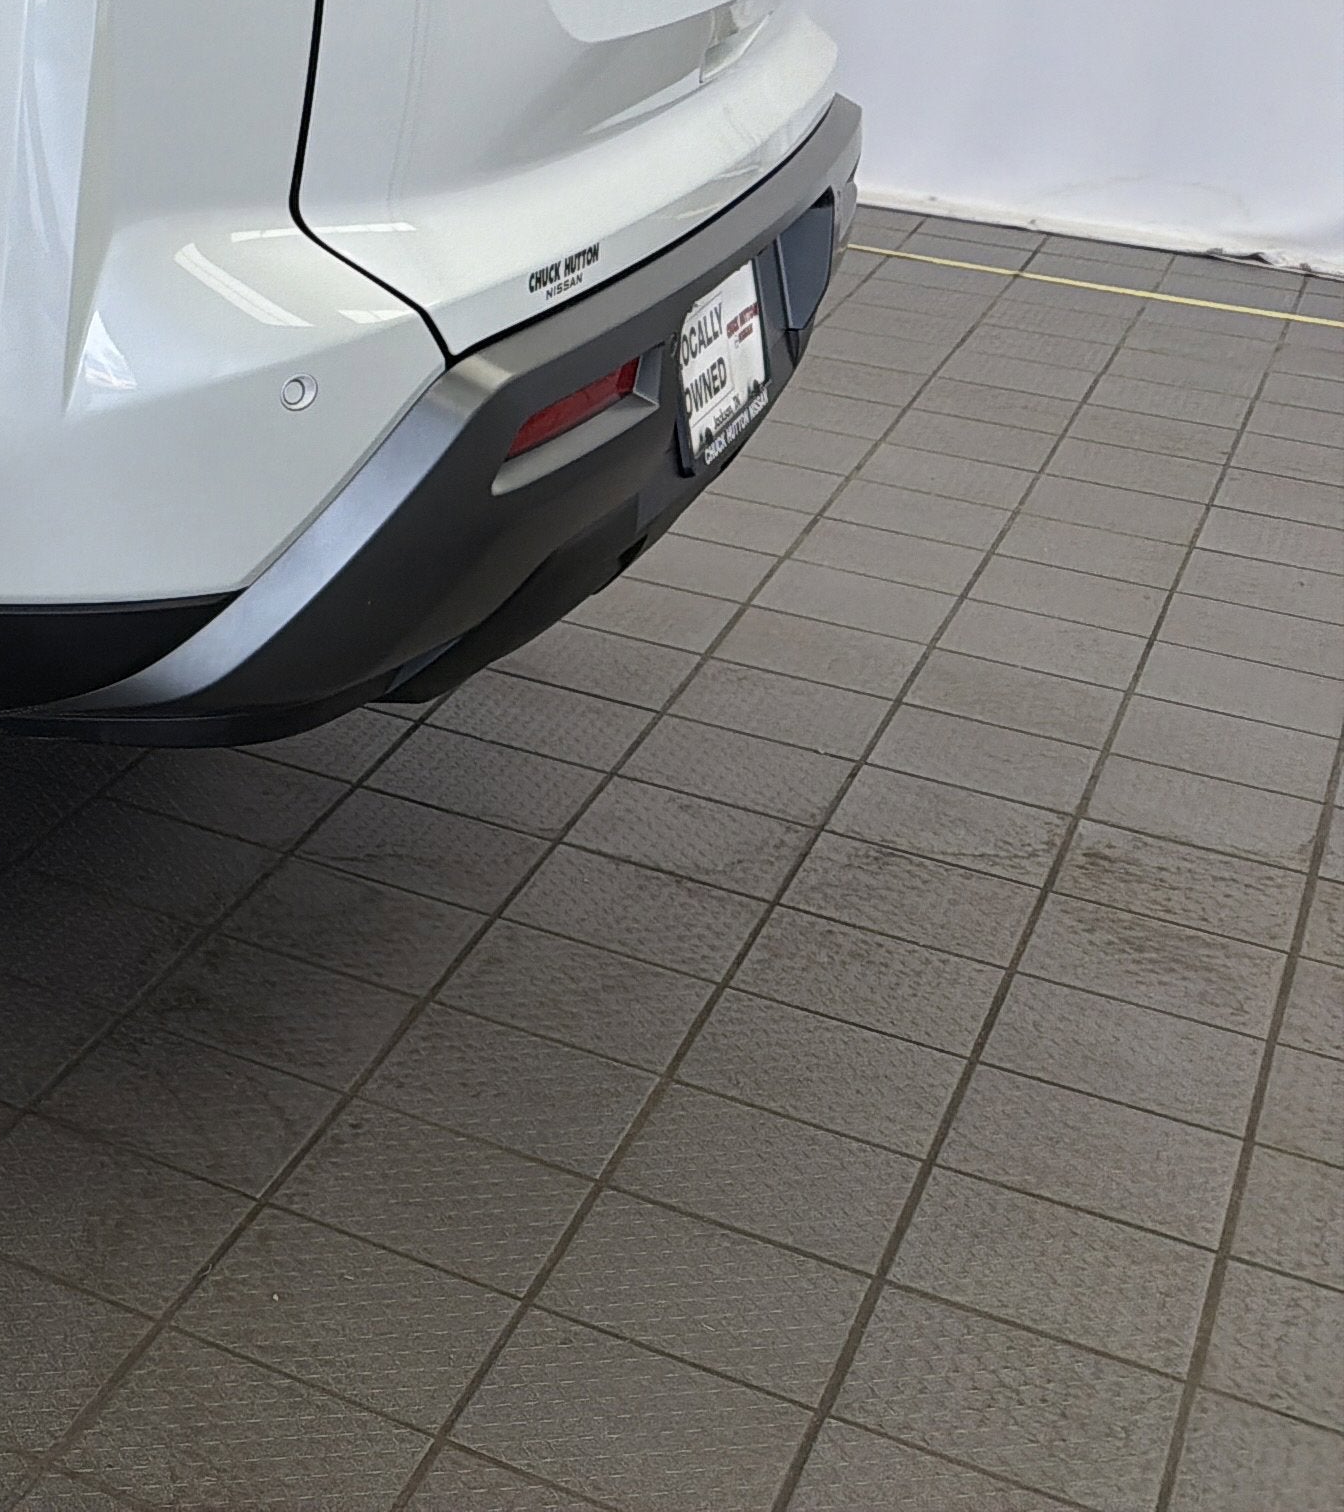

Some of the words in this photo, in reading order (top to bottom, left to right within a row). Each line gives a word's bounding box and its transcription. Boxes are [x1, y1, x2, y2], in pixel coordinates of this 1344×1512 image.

[528, 261, 561, 294] CHUCK
[564, 242, 600, 277] HUTTON
[545, 272, 583, 300] NISSAN
[680, 302, 723, 368] OCALLY
[685, 356, 727, 416] OWNED
